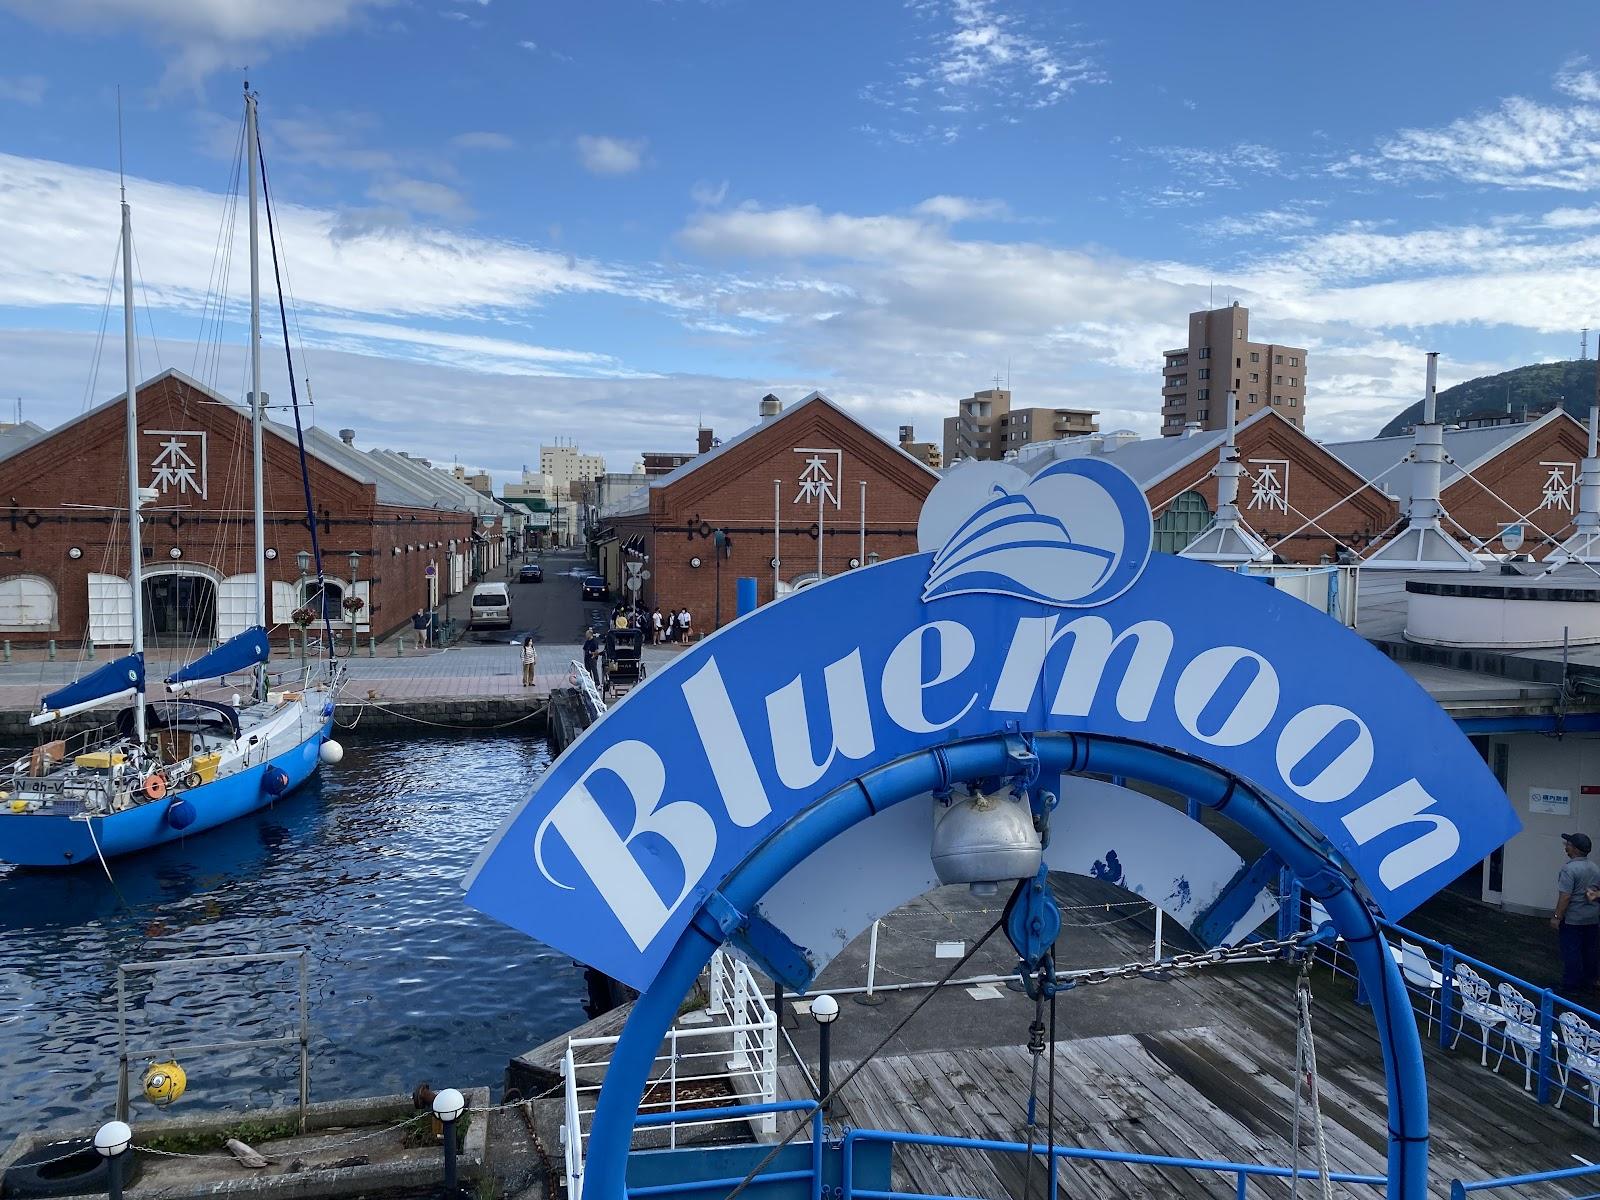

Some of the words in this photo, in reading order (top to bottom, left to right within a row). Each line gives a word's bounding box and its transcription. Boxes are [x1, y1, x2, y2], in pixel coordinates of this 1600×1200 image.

[147, 437, 203, 494] 森
[793, 455, 838, 504] 森
[1246, 464, 1285, 510] 森
[1539, 467, 1571, 510] 森
[534, 613, 1460, 954] Bluemoon
